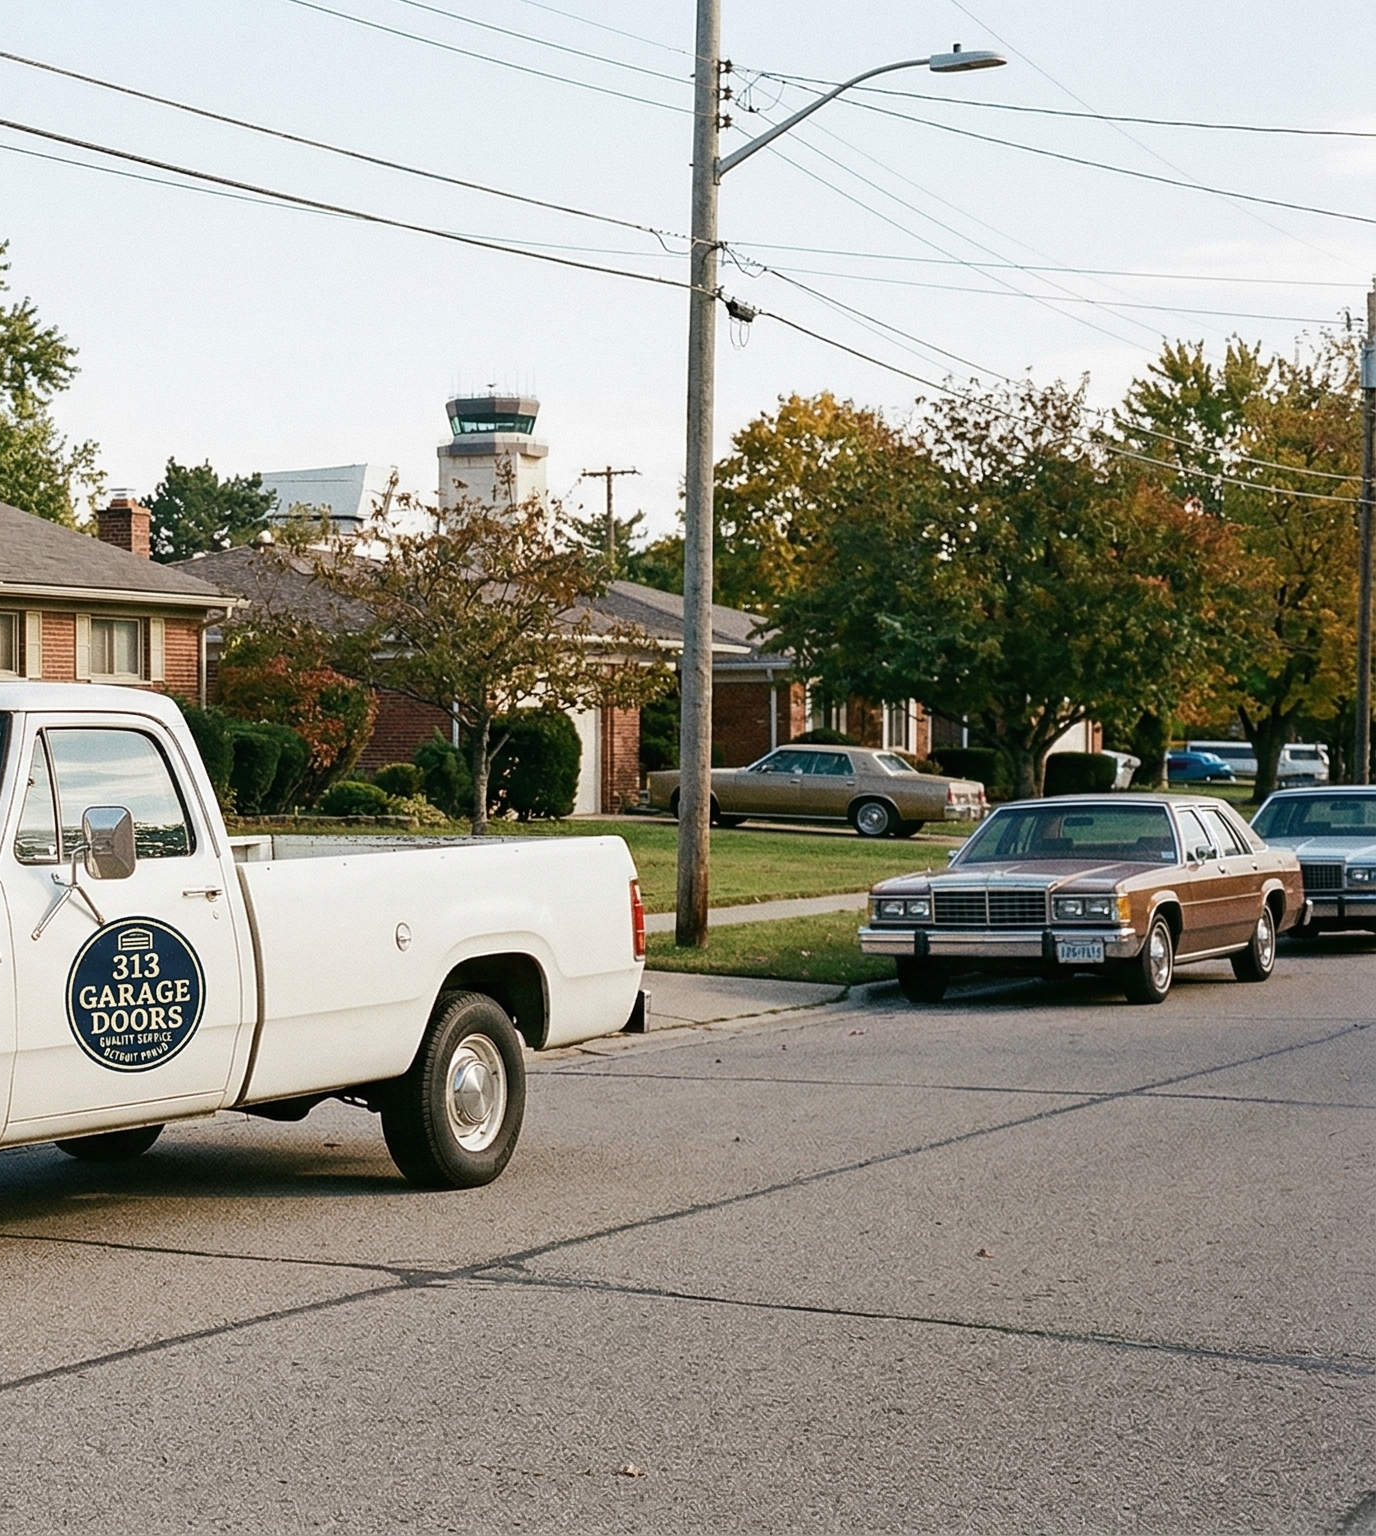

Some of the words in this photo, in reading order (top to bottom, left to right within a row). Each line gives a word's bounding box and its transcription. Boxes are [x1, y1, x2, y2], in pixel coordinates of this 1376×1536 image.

[112, 953, 161, 980] 313
[79, 979, 191, 1009] GARAGE
[91, 1006, 183, 1035] DOORS
